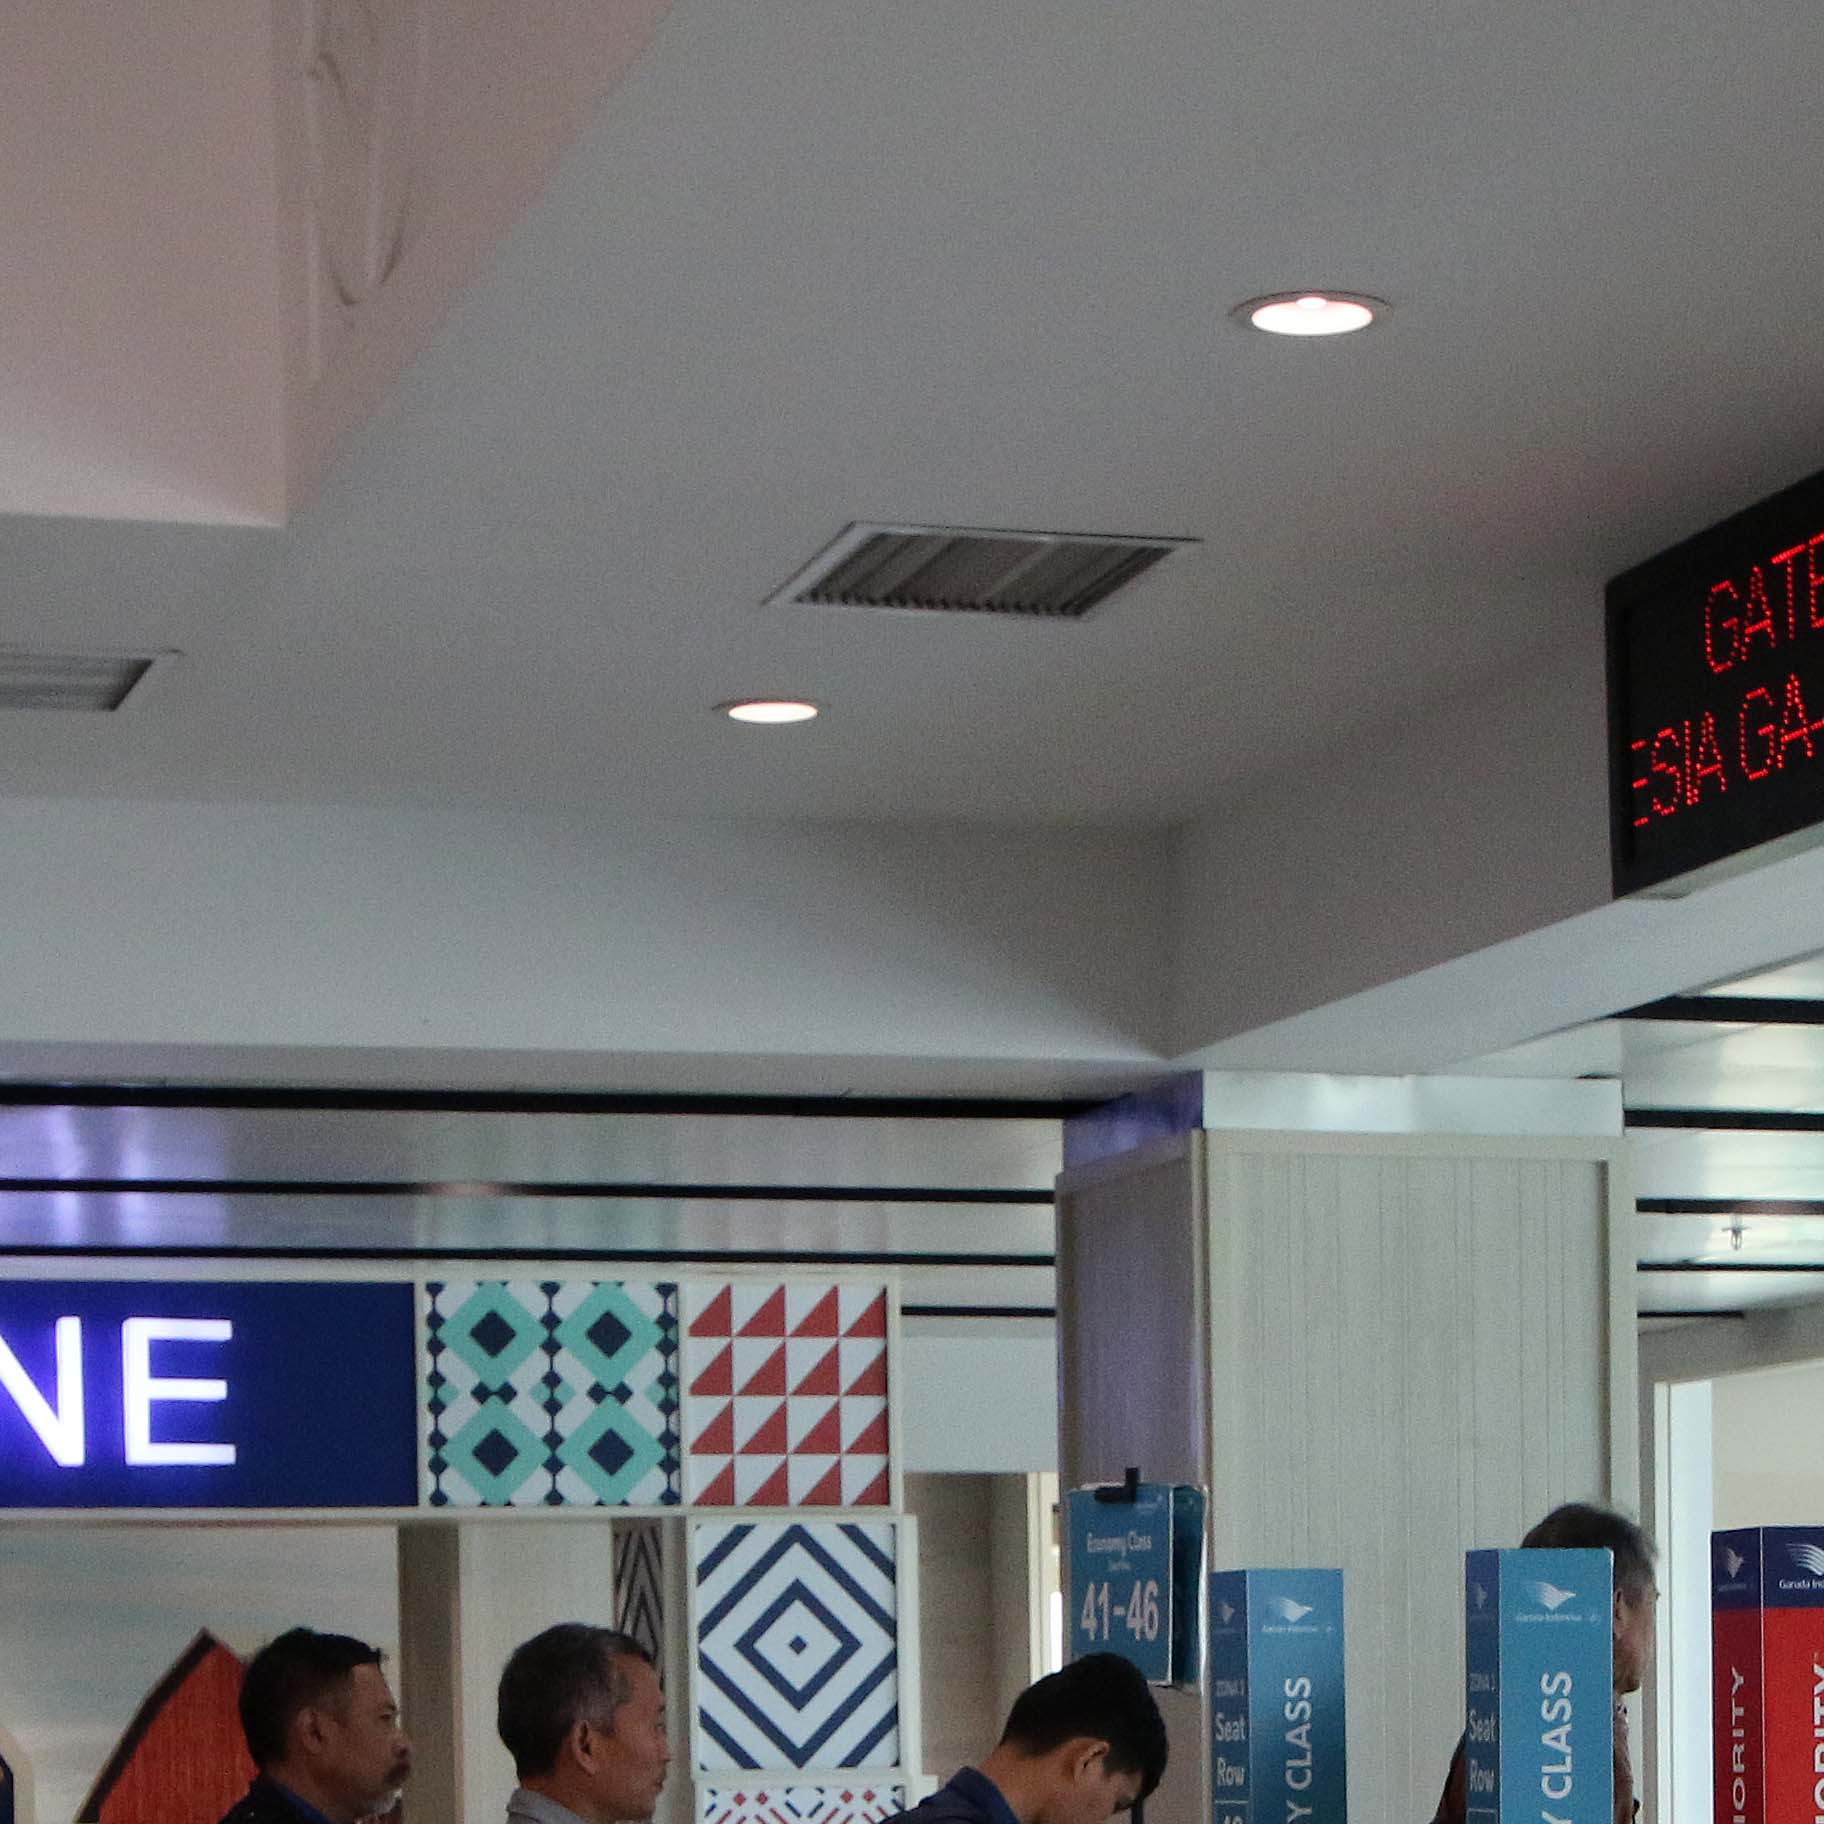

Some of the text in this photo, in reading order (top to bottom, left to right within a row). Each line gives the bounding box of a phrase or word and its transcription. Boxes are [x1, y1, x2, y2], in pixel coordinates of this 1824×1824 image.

[1080, 1579, 1160, 1642] 41-46
[1215, 1712, 1246, 1743] Seat
[1285, 1677, 1313, 1790] CLASS
[1469, 1709, 1496, 1744] Seat
[1541, 1671, 1573, 1800] CLASS
[1216, 1757, 1245, 1787] Row
[1469, 1758, 1495, 1793] Row
